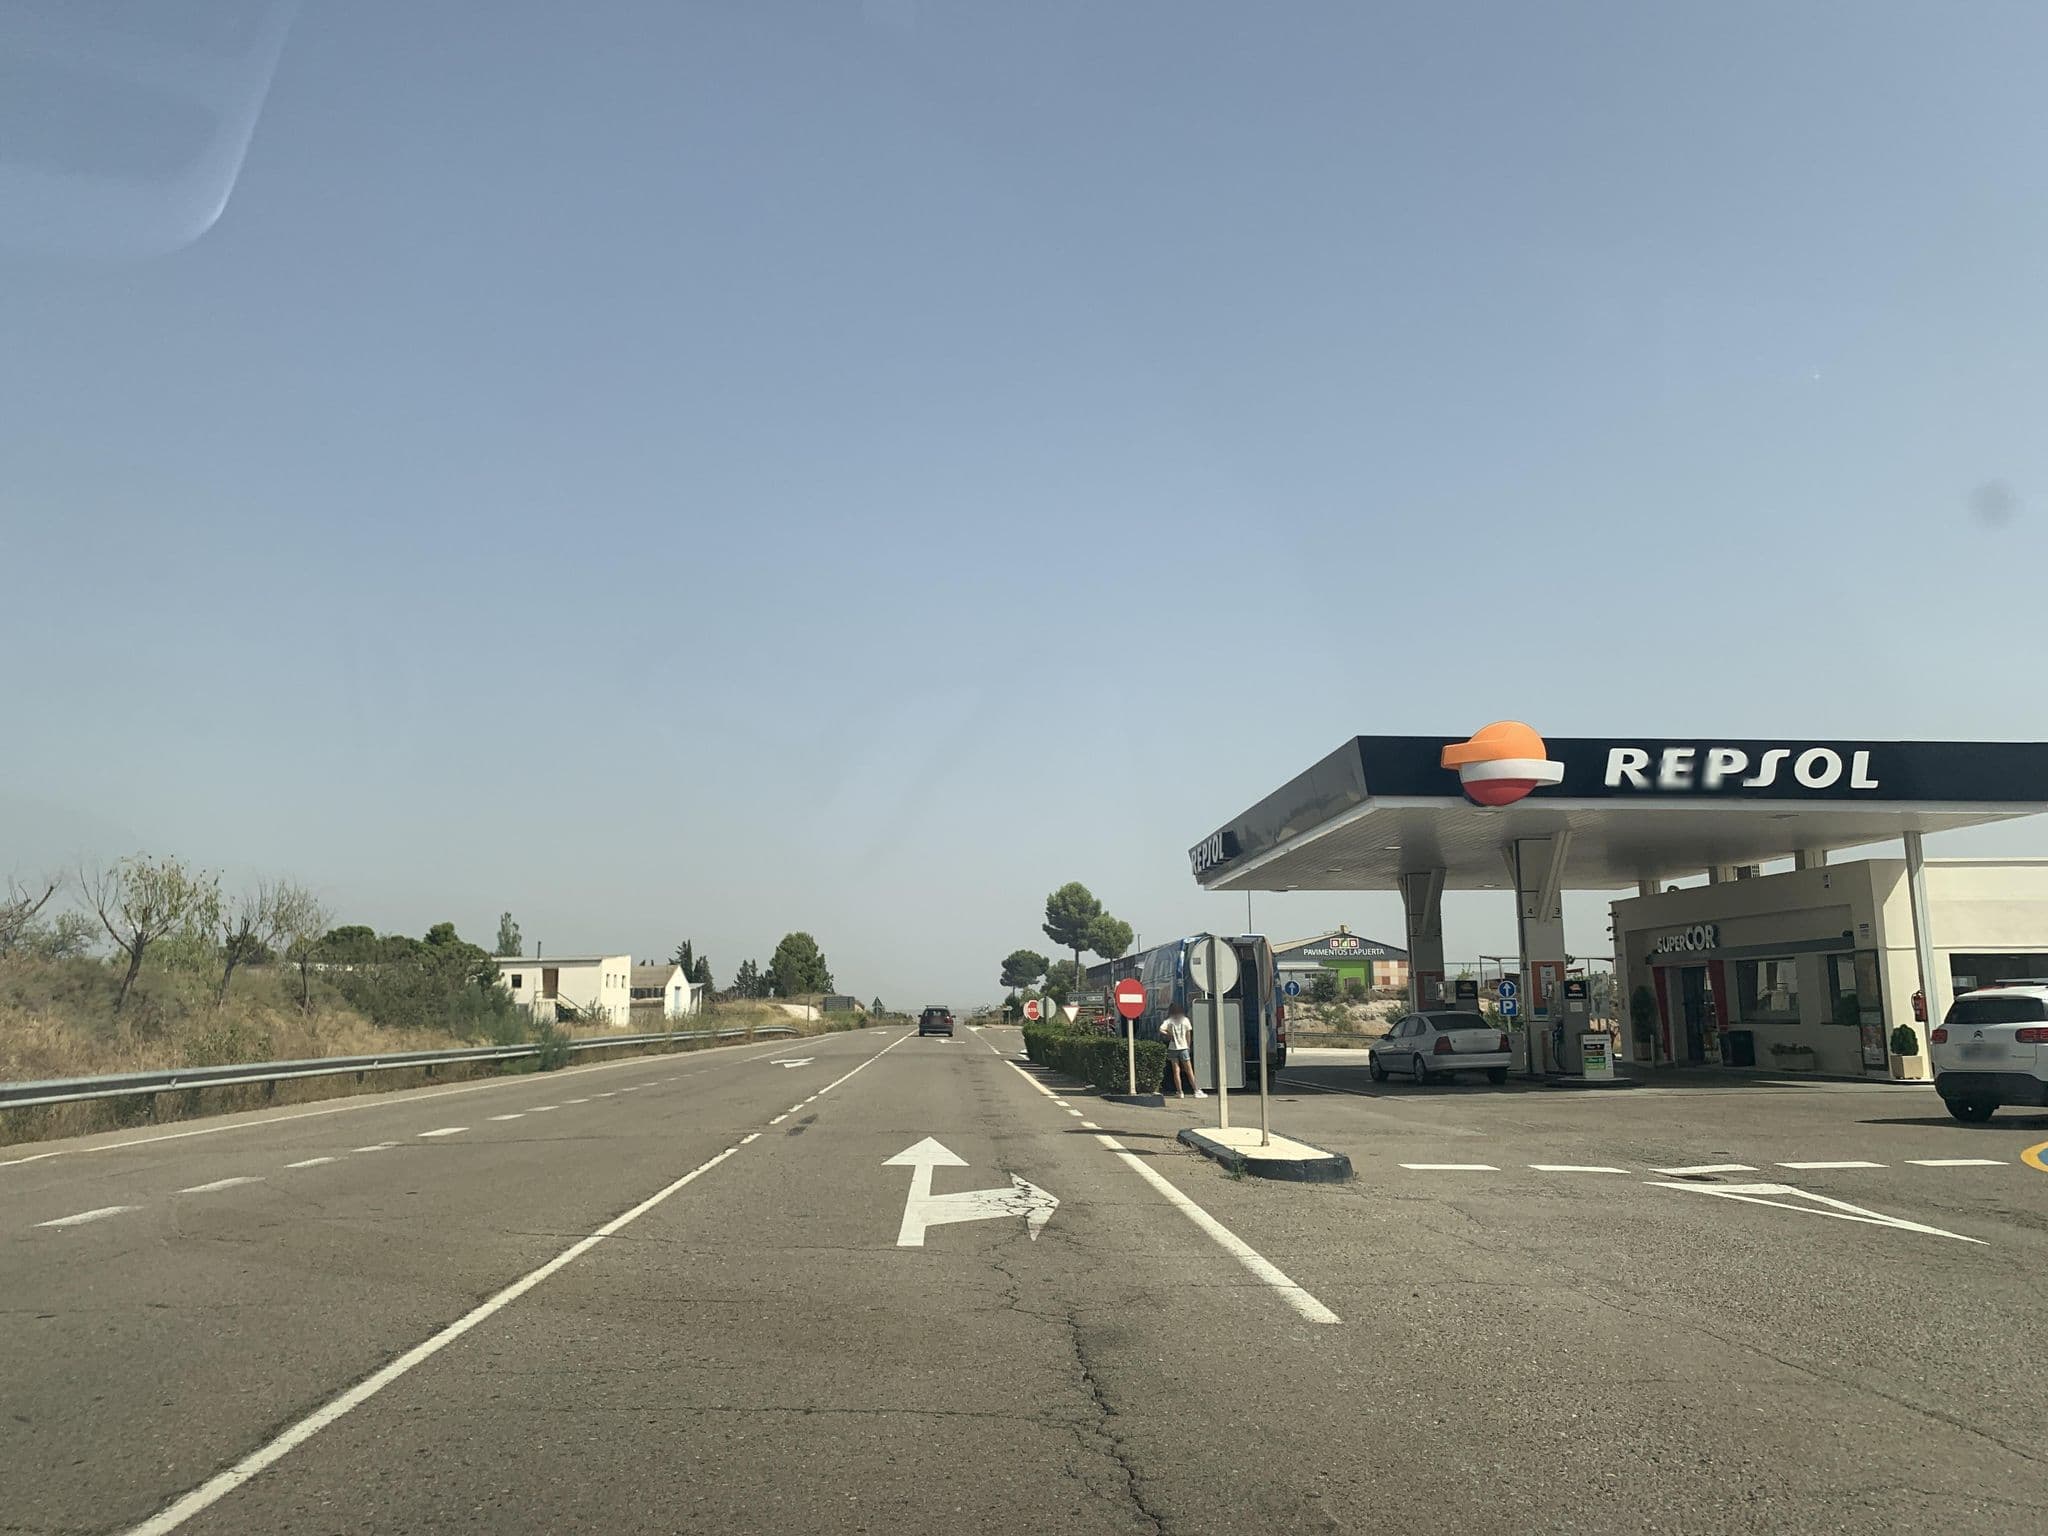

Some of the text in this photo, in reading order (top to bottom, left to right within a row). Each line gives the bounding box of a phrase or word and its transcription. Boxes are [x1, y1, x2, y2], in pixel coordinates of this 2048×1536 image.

[1604, 747, 1880, 790] REPSOL
[1191, 832, 1225, 874] REPSOL
[1303, 948, 1385, 956] PAVIMENTOS LAPUERTA
[1503, 1001, 1514, 1013] P
